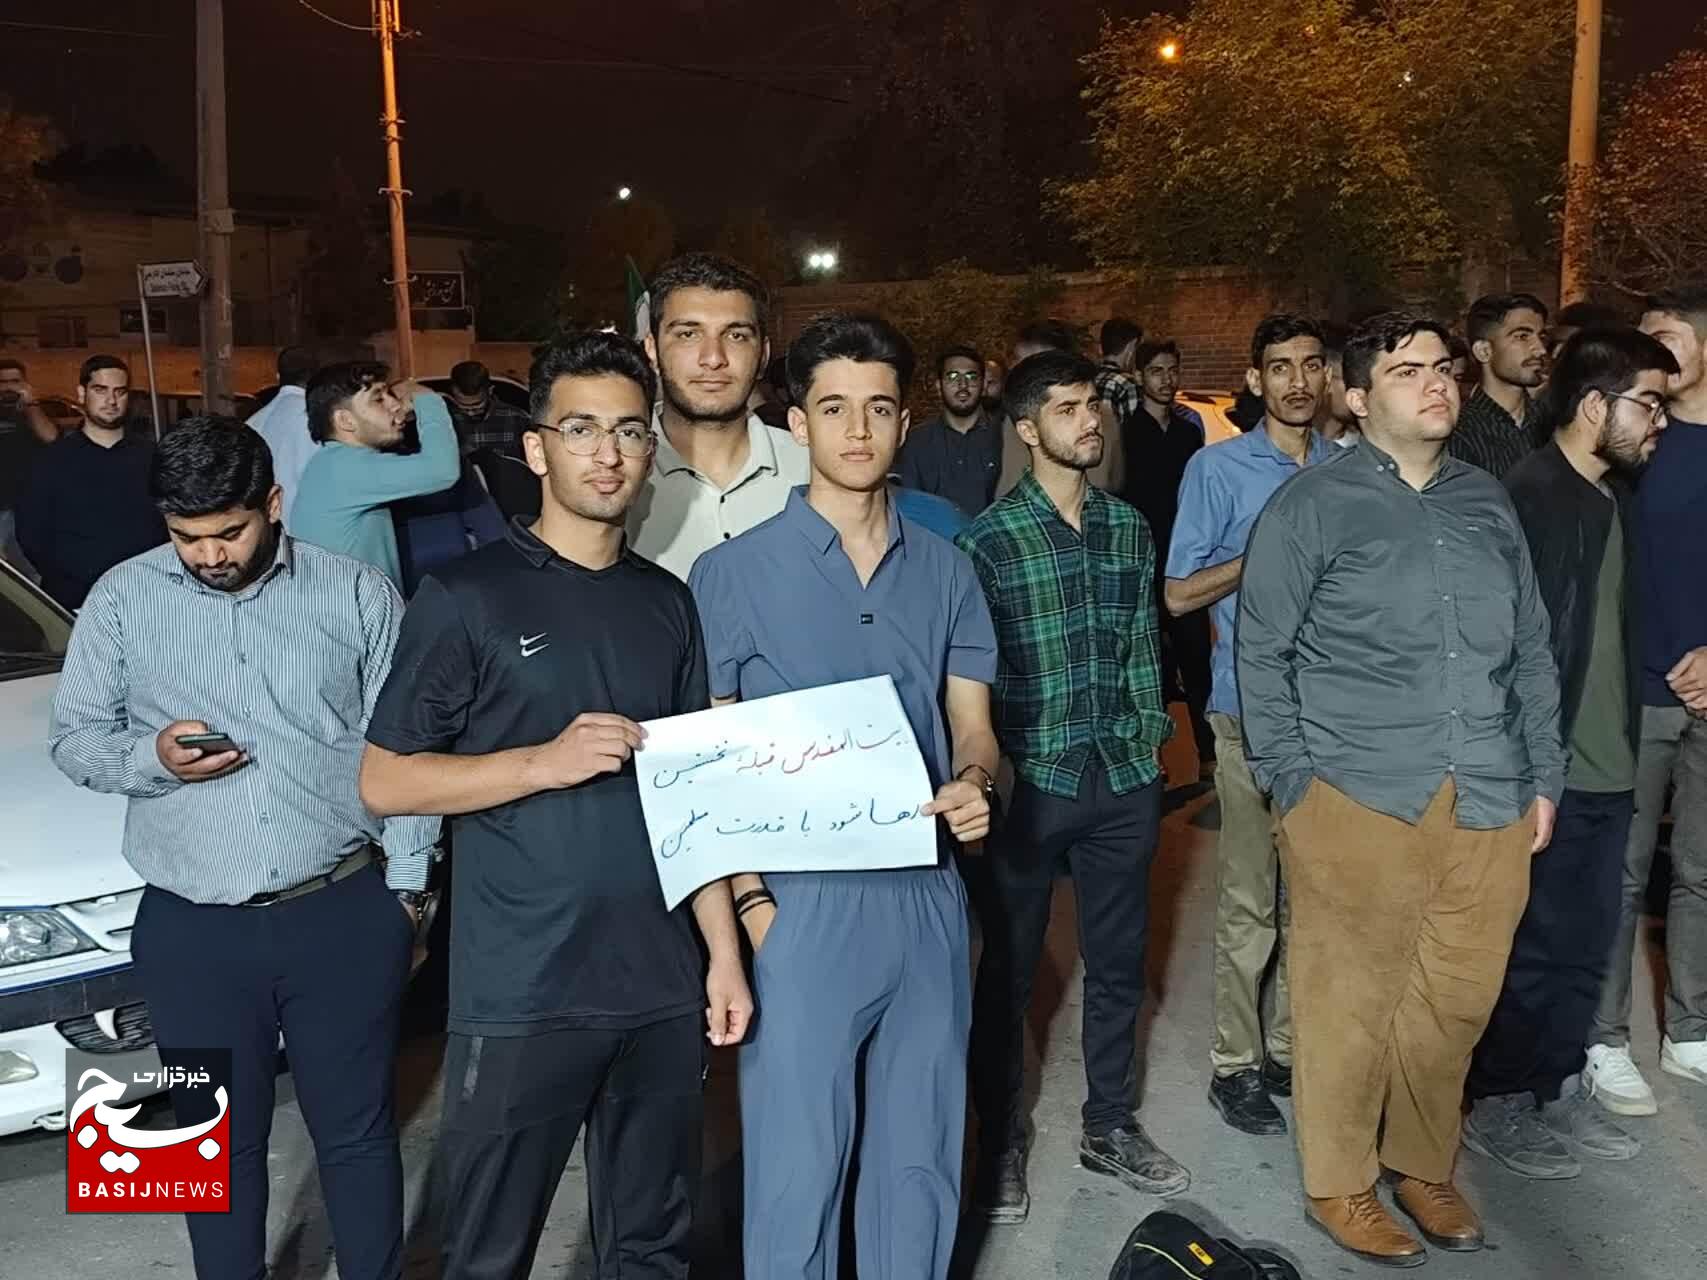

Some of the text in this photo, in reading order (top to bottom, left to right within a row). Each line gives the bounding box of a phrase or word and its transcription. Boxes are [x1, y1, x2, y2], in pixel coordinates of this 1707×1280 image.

[800, 810, 811, 837] با
[829, 803, 862, 831] شود
[870, 798, 920, 825] رها
[716, 817, 784, 835] قدرت
